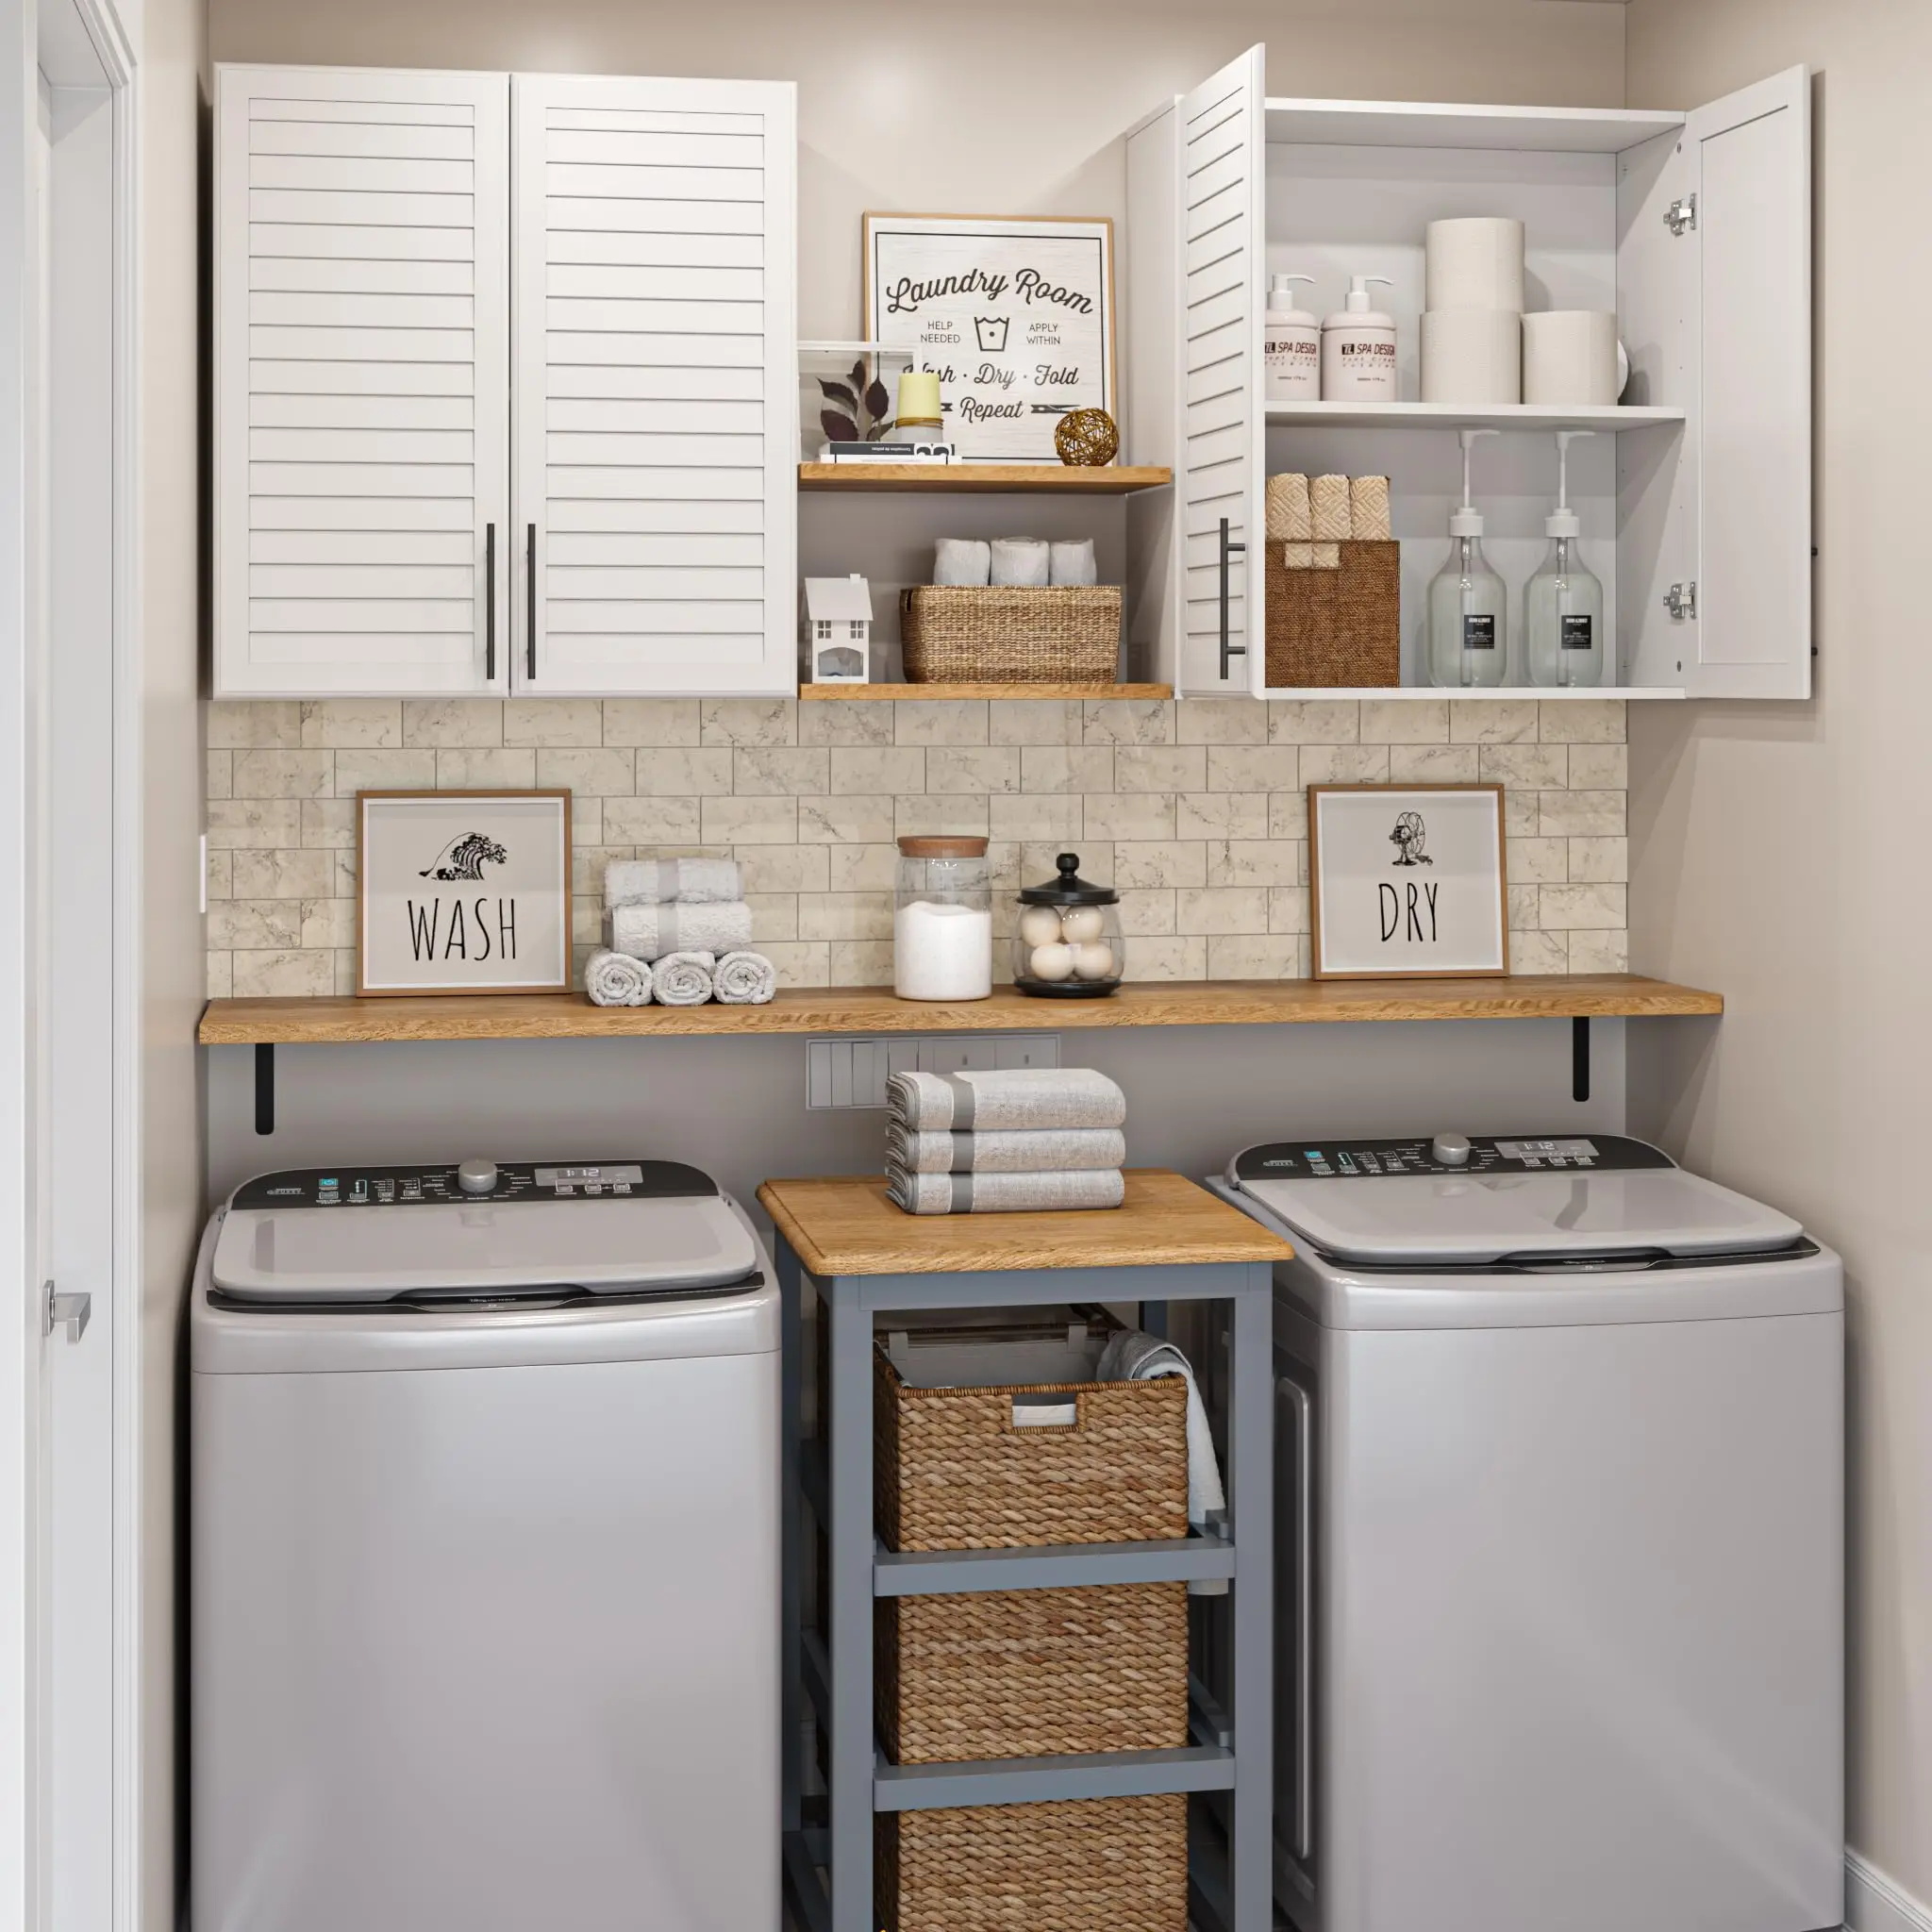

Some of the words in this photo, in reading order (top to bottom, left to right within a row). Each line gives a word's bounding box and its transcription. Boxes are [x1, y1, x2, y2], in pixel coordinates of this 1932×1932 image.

[886, 268, 1008, 313] Laundry
[1015, 268, 1093, 314] Room
[927, 321, 953, 330] HELP
[1028, 324, 1058, 333] APPLY
[920, 333, 961, 343] NEEDED
[1025, 335, 1061, 345] WITHIN
[1277, 341, 1293, 354] SPA
[1357, 343, 1373, 356] SPA
[974, 362, 1016, 390] Dry
[1034, 364, 1079, 386] Fold
[959, 396, 1024, 424] Repeat
[1378, 882, 1438, 942] DRY
[407, 897, 516, 961] WASH
